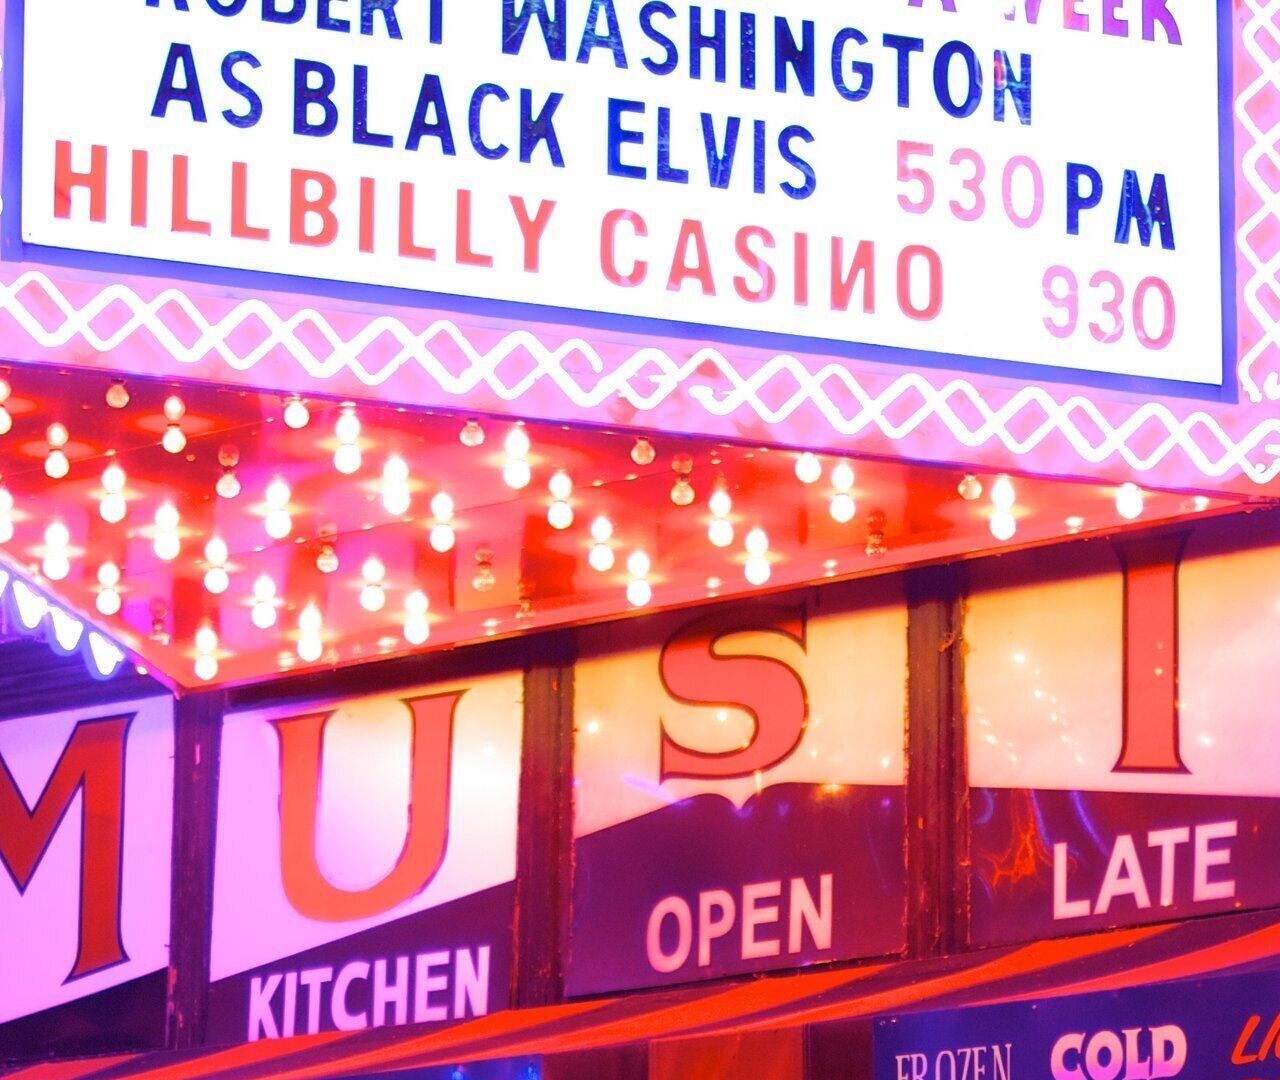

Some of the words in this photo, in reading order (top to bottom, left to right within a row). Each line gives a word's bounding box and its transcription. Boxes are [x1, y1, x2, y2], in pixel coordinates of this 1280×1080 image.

[150, 42, 263, 128] AS
[293, 58, 565, 168] BLACK
[607, 97, 817, 199] ELVIS
[897, 140, 1044, 229] 530
[1066, 162, 1175, 251] PM
[502, 0, 1031, 125] WASHINGTON
[54, 140, 557, 273] HILLBILLY
[1041, 264, 1175, 350] 930
[247, 944, 491, 1042] KITCHEN
[646, 873, 833, 974] OPEN
[1053, 819, 1238, 920] LATE
